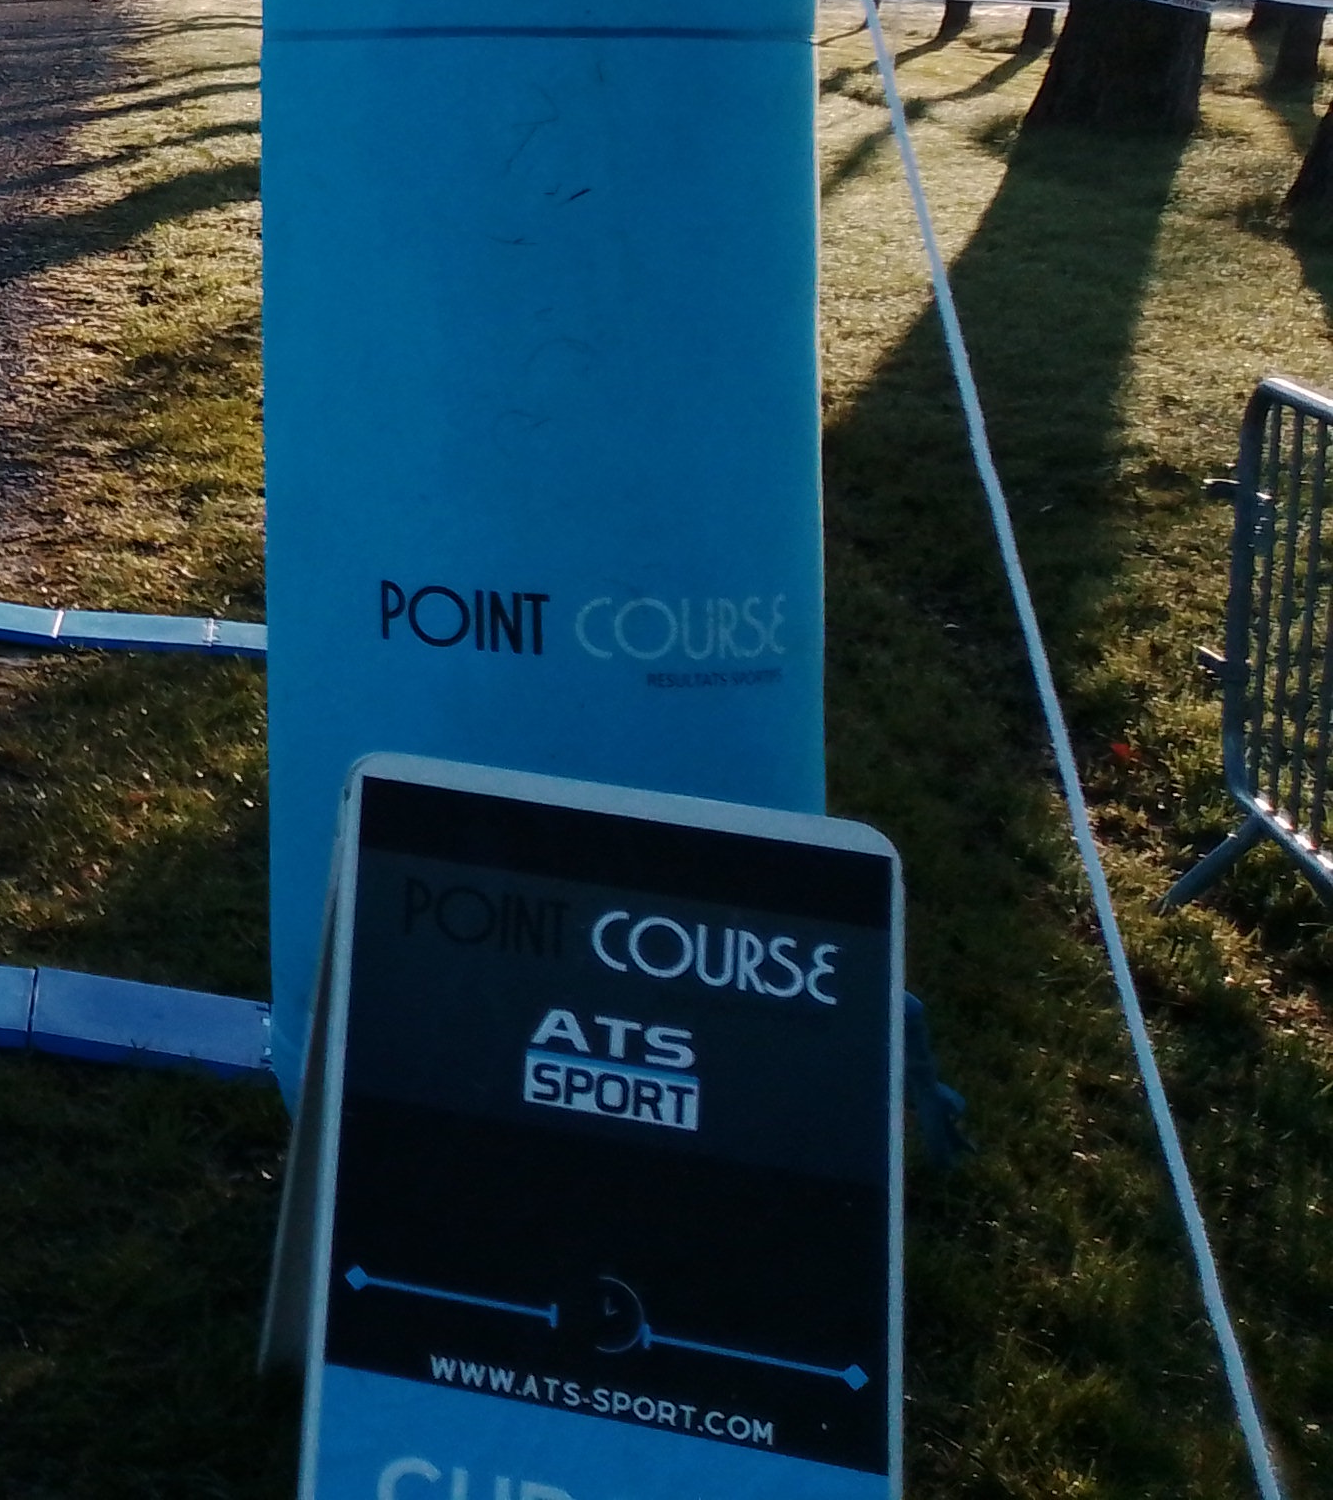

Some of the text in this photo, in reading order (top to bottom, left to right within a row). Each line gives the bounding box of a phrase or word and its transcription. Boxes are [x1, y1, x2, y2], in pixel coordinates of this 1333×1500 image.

[380, 579, 787, 660] POINT COURSE
[403, 876, 840, 1006] POINT COURSE
[530, 1007, 697, 1070] ATS
[530, 1062, 696, 1126] SPORT
[430, 1354, 775, 1446] WWW.ATS-SPORT.COM
